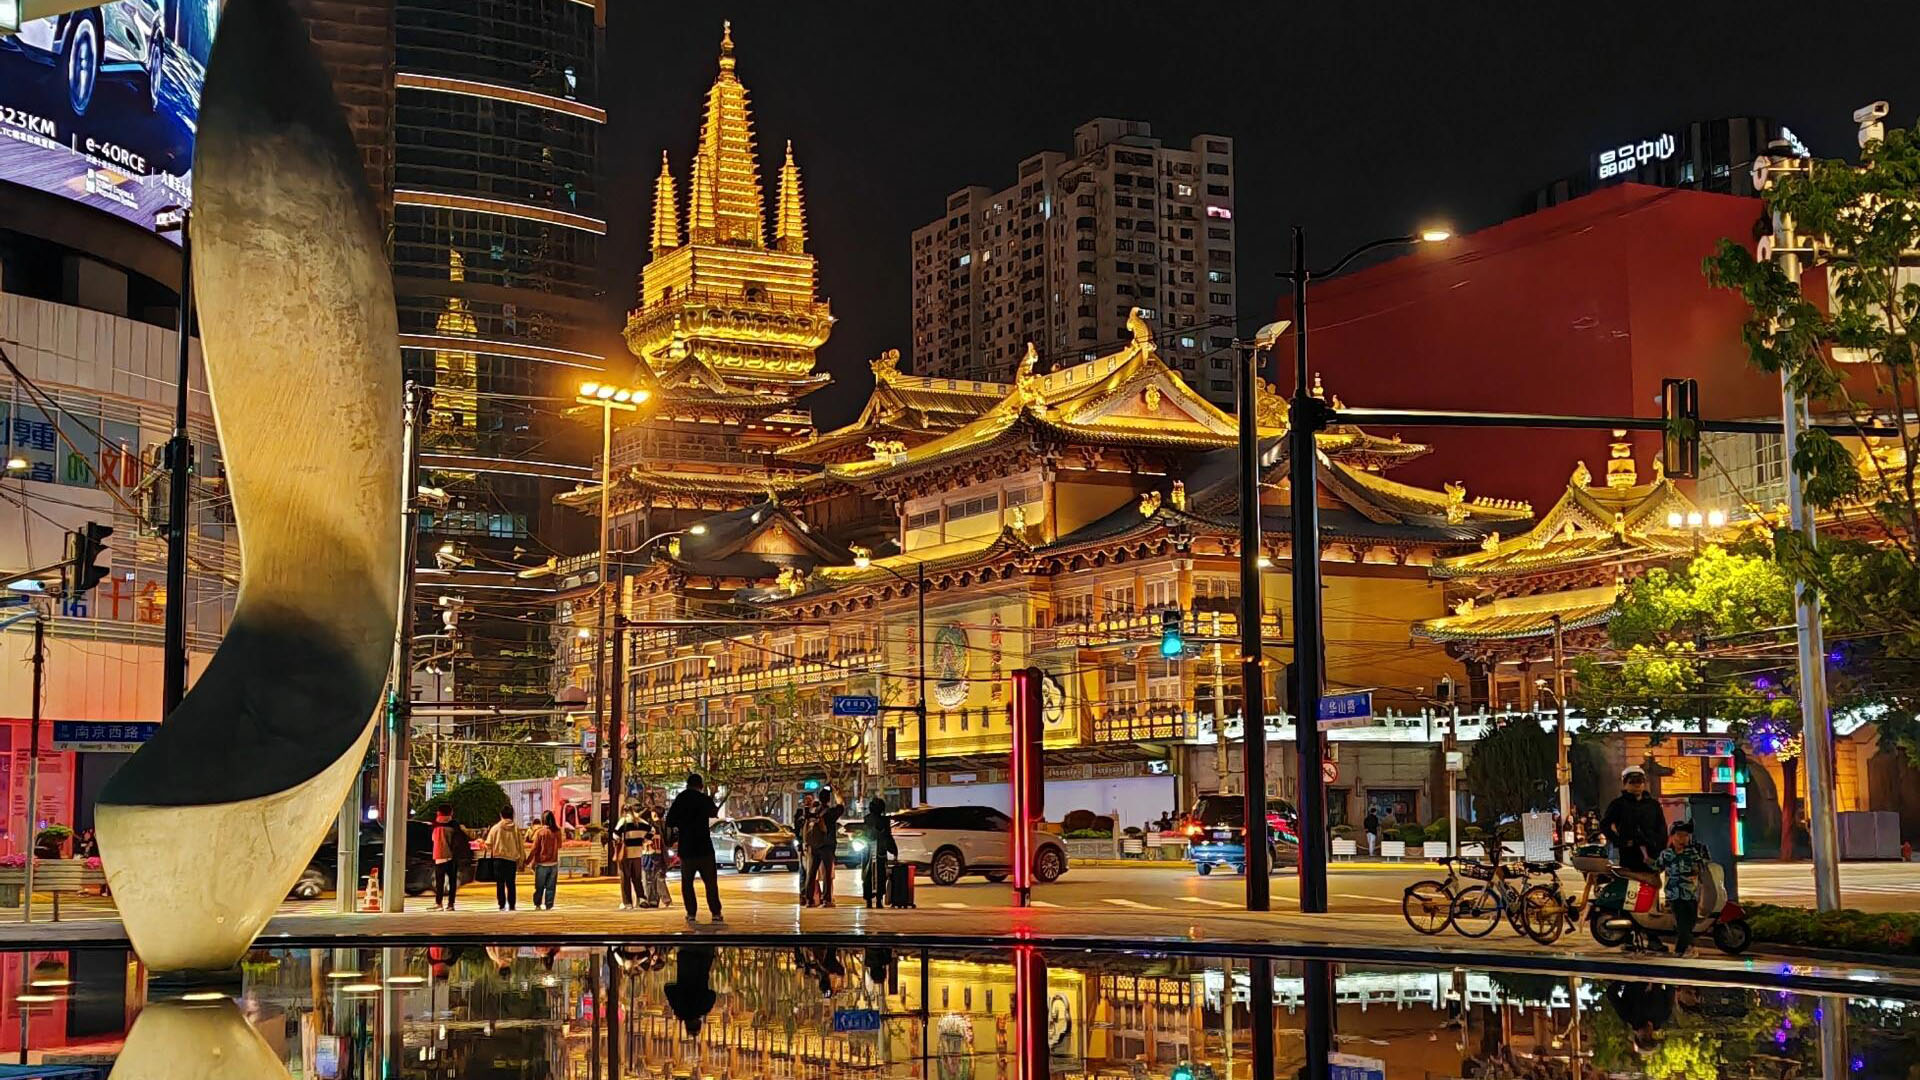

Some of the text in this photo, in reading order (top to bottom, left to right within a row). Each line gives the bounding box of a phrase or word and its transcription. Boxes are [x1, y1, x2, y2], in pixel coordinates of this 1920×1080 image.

[1599, 133, 1675, 179] 晶品中心
[1329, 699, 1356, 716] 华山路
[74, 724, 139, 740] 南京西路
